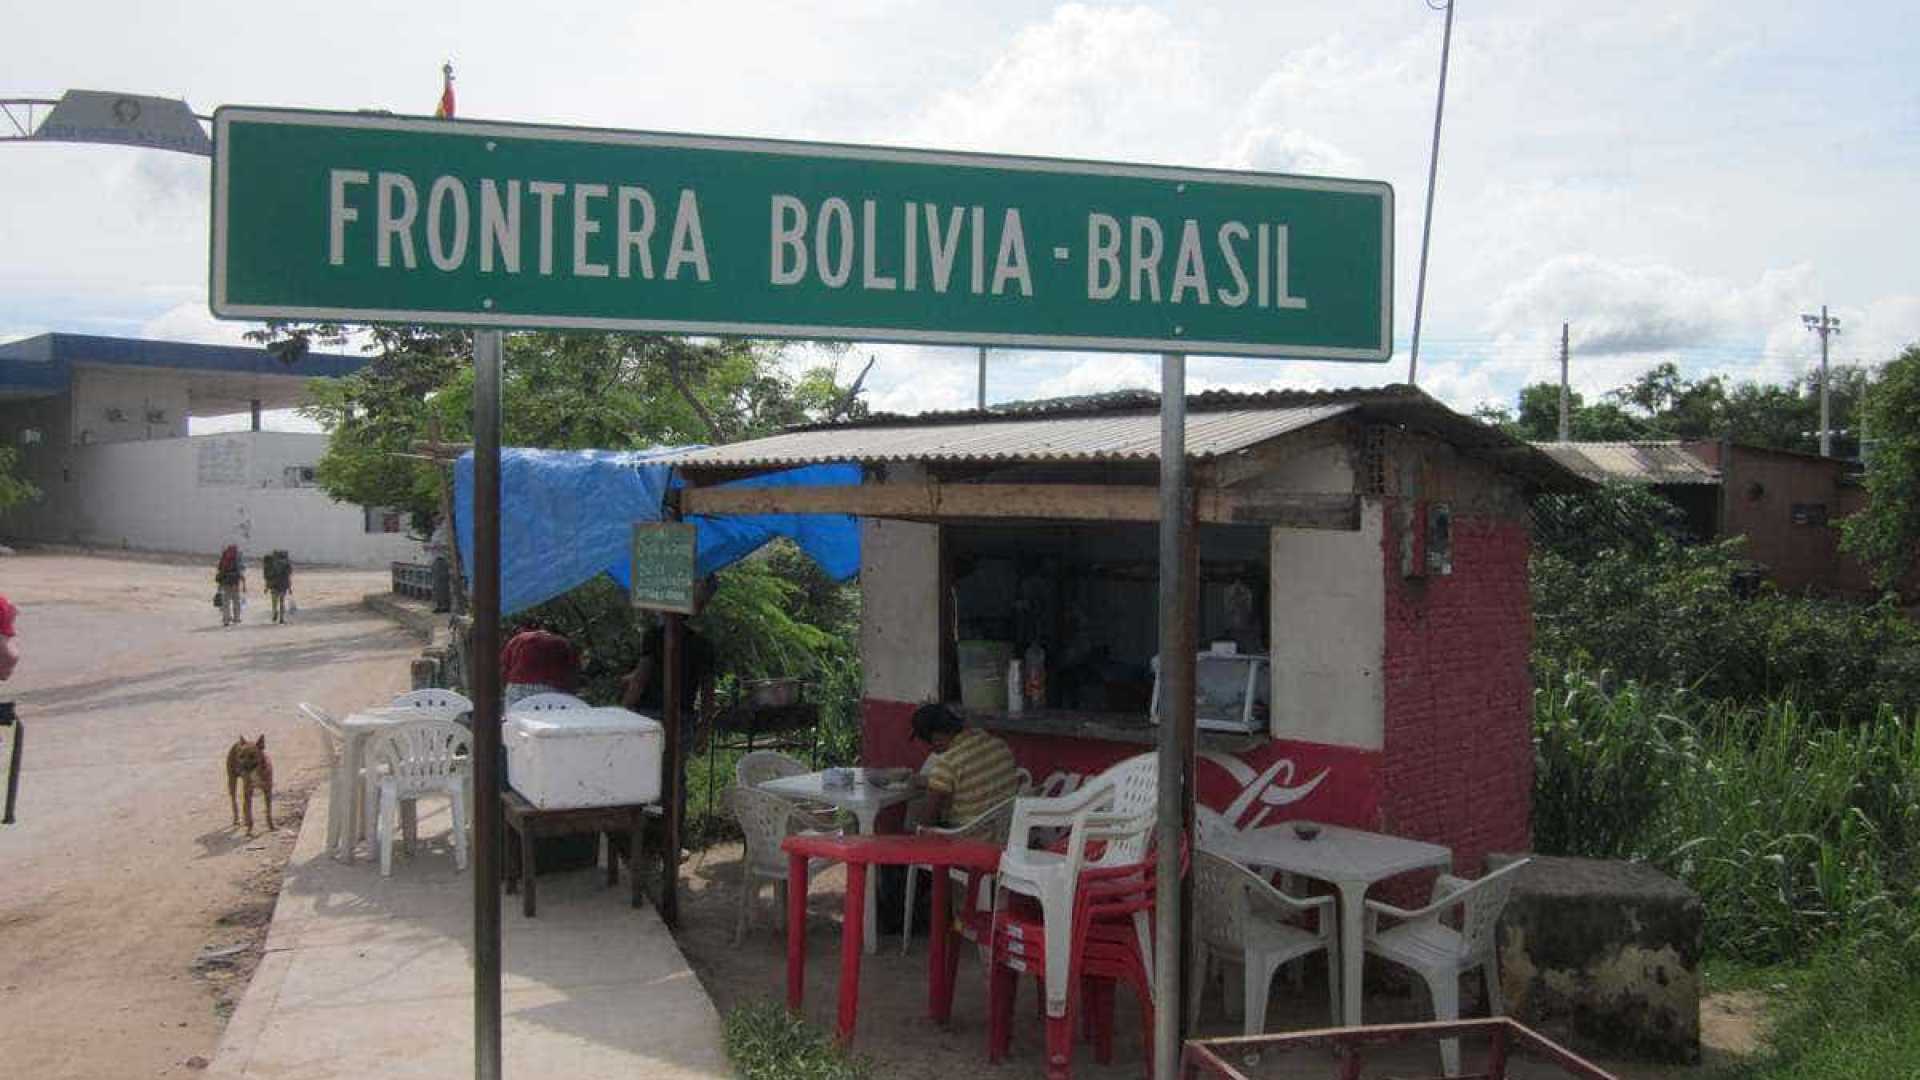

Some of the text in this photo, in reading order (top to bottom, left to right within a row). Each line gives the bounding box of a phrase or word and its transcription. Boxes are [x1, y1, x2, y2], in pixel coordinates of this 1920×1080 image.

[329, 168, 711, 283] FRONTERA
[769, 193, 1034, 297] BOLIVIA
[1087, 210, 1308, 310] BRASIL
